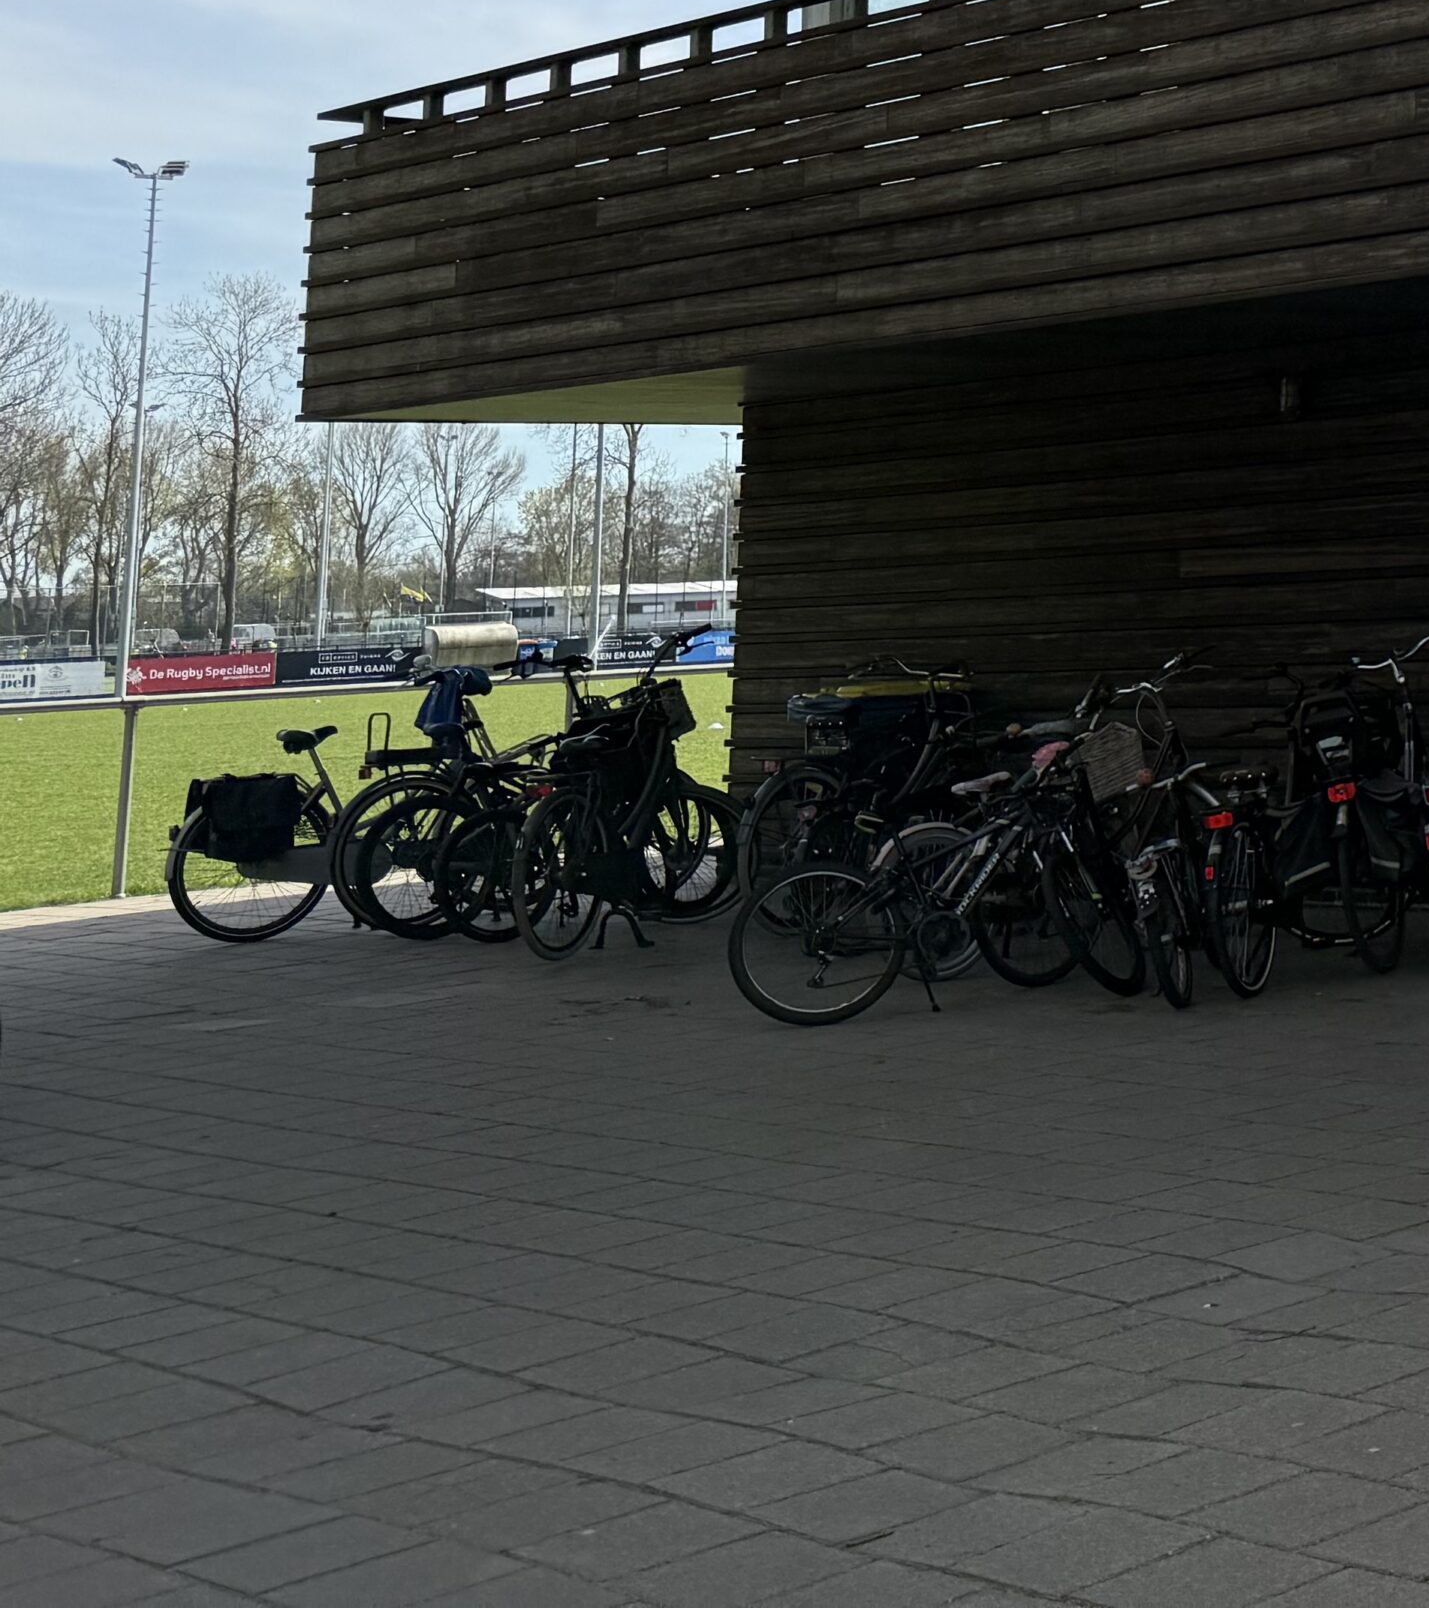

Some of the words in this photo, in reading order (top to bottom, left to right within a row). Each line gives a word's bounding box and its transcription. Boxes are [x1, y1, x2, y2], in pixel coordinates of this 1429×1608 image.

[613, 651, 626, 660] EN
[149, 669, 164, 679] De
[166, 667, 203, 681] Rugby
[205, 663, 271, 678] Specialist.nl
[309, 666, 346, 676] KIJKEN
[348, 665, 362, 674] EN
[364, 664, 396, 673] GAAN!
